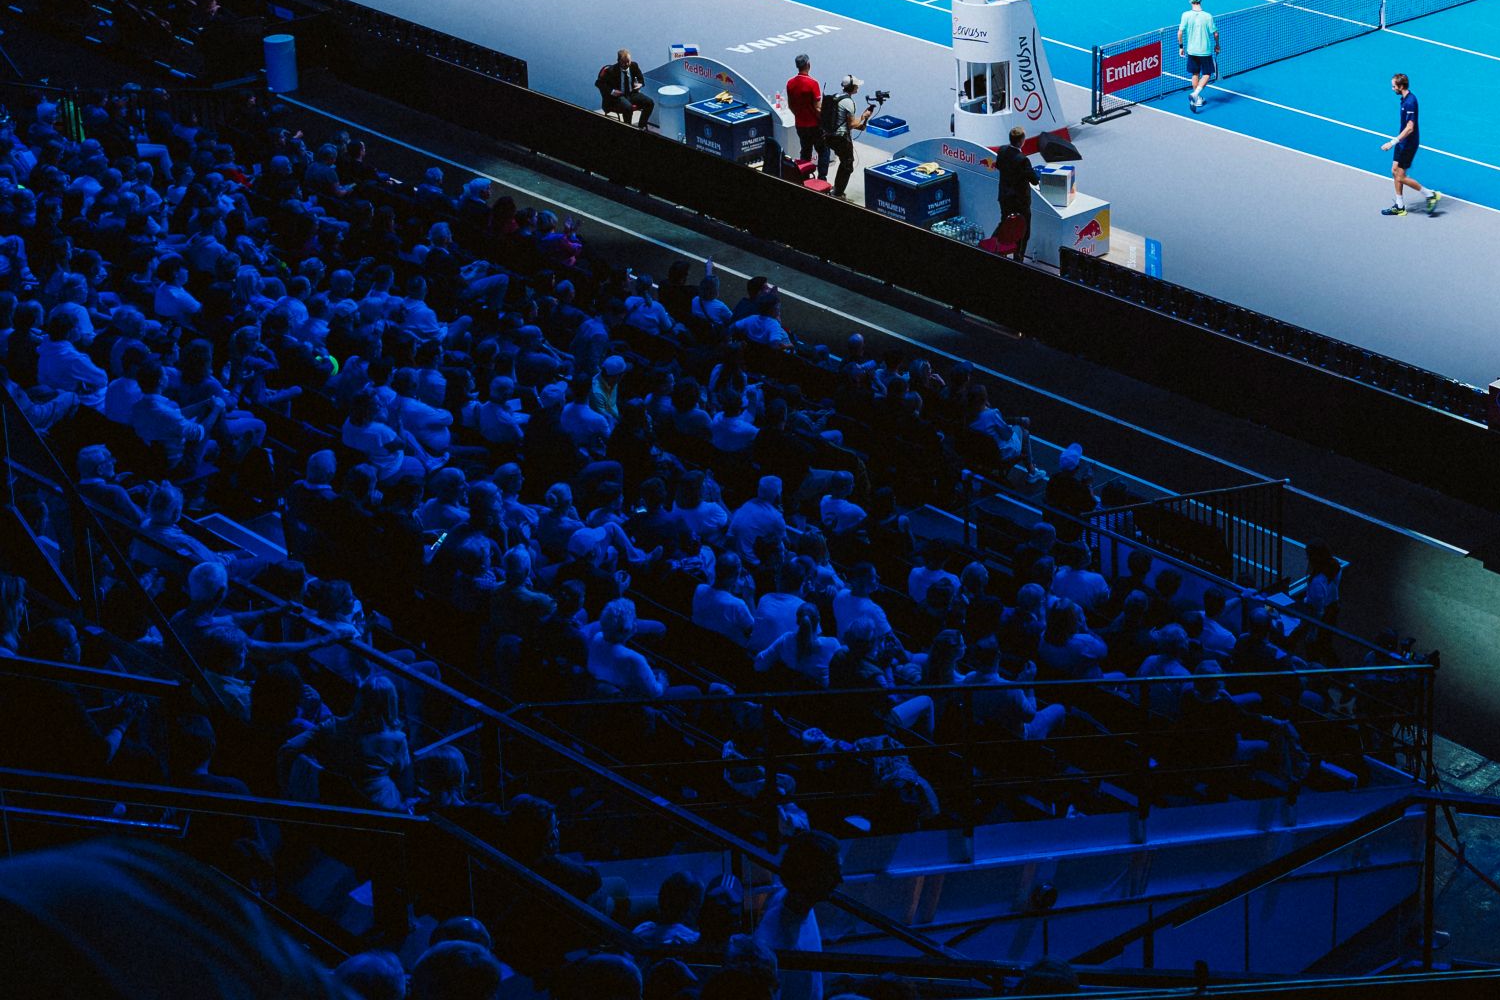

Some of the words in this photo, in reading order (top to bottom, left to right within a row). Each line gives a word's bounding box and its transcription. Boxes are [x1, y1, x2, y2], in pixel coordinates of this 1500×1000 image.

[726, 24, 841, 54] VIENNA
[684, 61, 698, 74] Red
[698, 66, 712, 78] Bull
[1106, 53, 1159, 83] Emirates
[943, 144, 958, 159] Red
[960, 150, 975, 165] Bull
